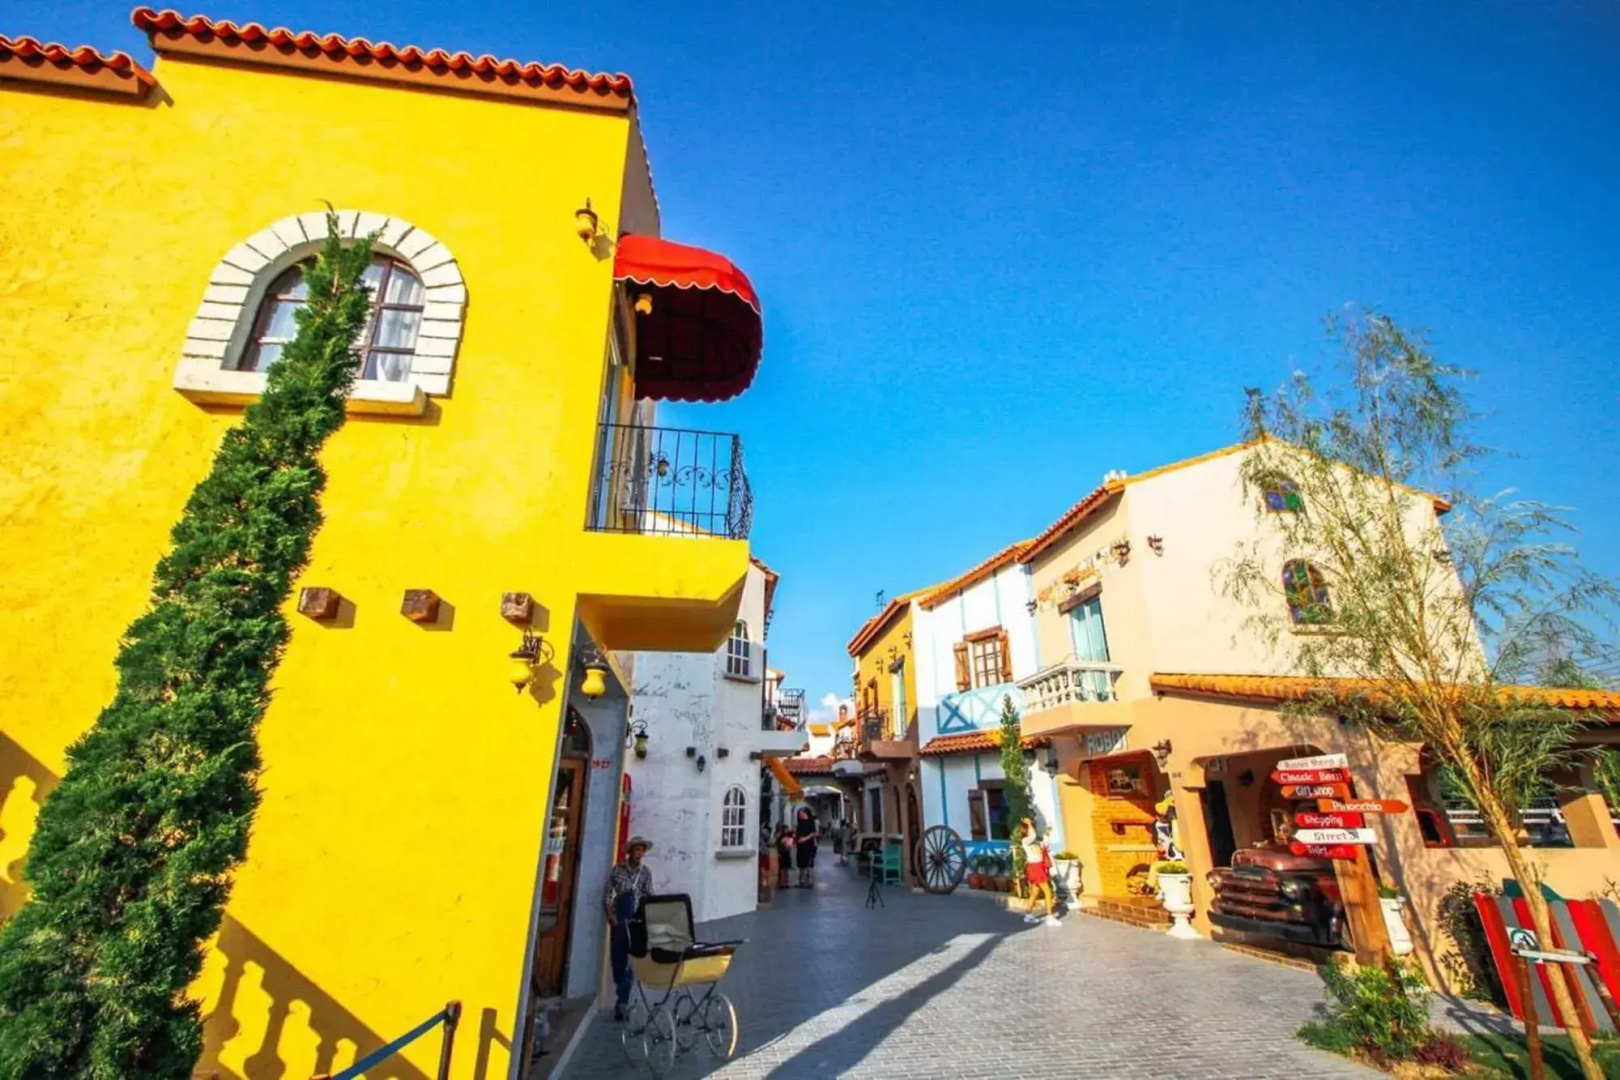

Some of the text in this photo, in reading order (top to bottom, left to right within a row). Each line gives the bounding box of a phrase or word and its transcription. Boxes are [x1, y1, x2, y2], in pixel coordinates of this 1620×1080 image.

[1331, 799, 1383, 811] Pinocchio
[1303, 814, 1344, 827] Shopping
[1313, 831, 1348, 841] Street
